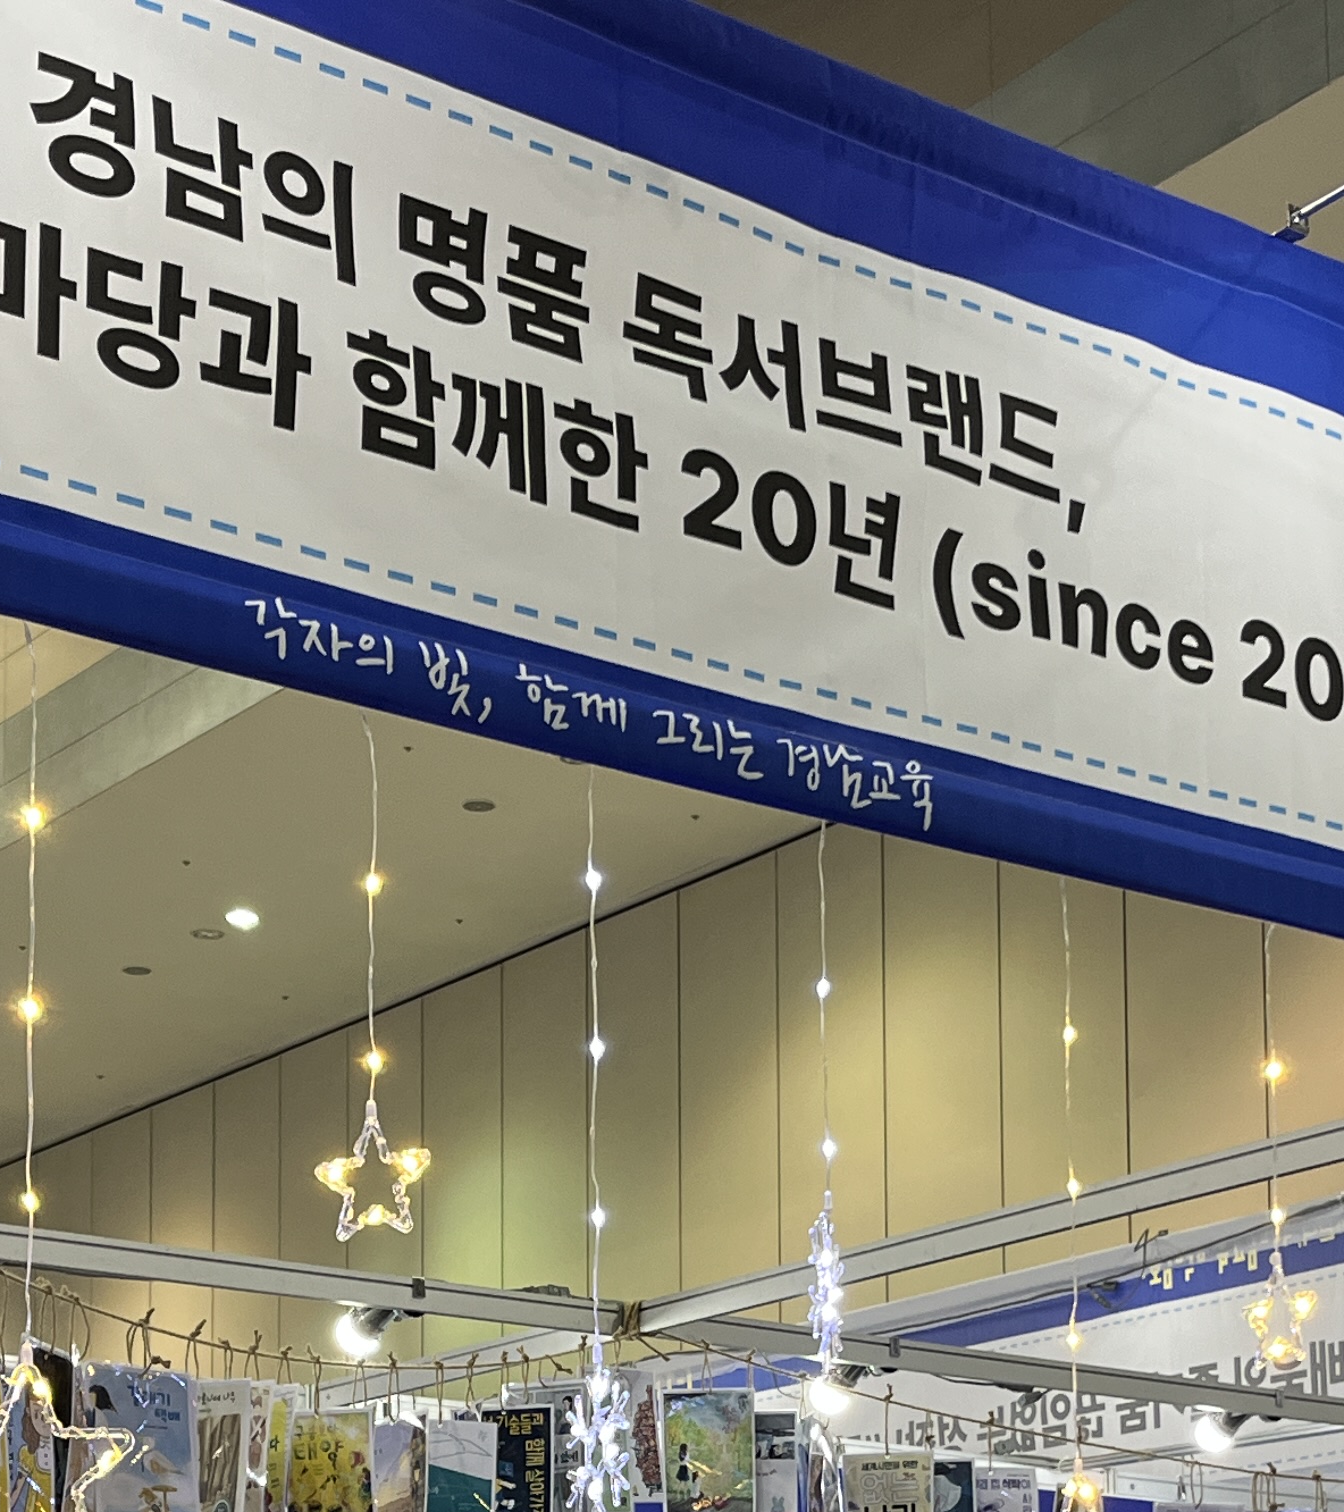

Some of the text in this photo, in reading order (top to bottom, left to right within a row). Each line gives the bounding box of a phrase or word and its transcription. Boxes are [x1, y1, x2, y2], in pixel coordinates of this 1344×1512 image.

[31, 50, 1088, 531] 경남의 명품 독서브랜드,
[346, 327, 648, 535] 함께한
[681, 450, 902, 610] 20년
[931, 530, 1216, 689] (since
[245, 596, 934, 832] 각자의 빛, 함께 그리는 경남교육
[496, 1413, 545, 1436] 기술들과
